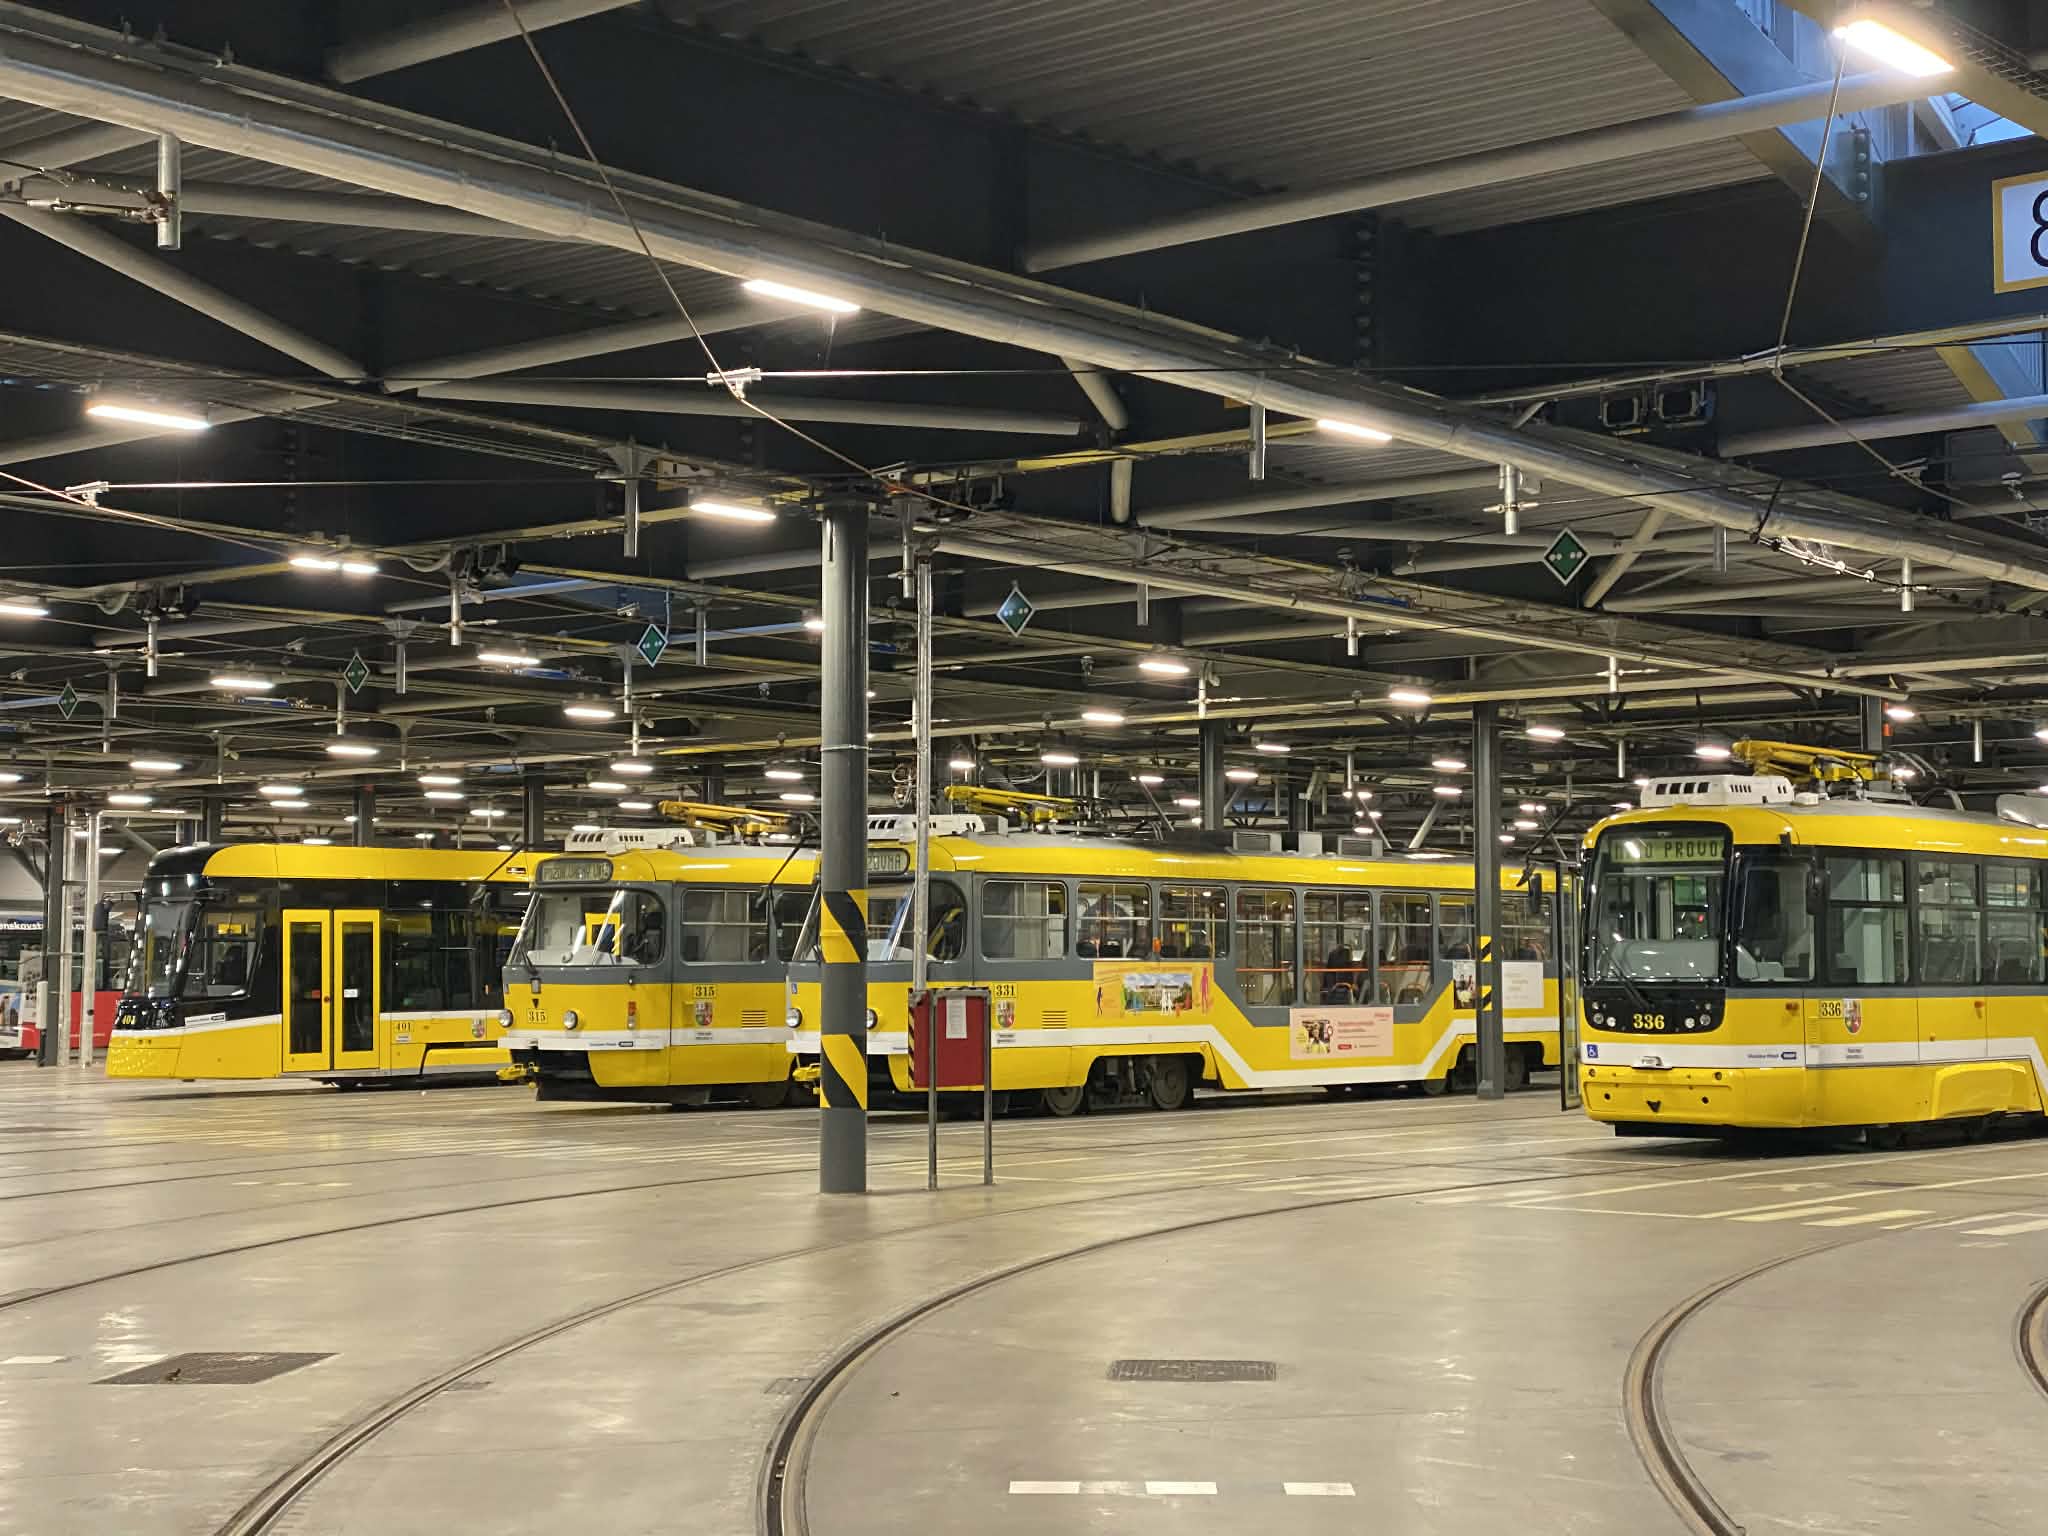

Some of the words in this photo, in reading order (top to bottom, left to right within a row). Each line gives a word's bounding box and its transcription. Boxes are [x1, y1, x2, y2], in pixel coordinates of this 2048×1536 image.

[1664, 841, 1725, 859] PROVO
[695, 986, 715, 997] 315
[996, 984, 1015, 996] 331
[528, 1010, 546, 1022] 315
[1821, 1002, 1842, 1017] 336
[1633, 1013, 1665, 1030] 336
